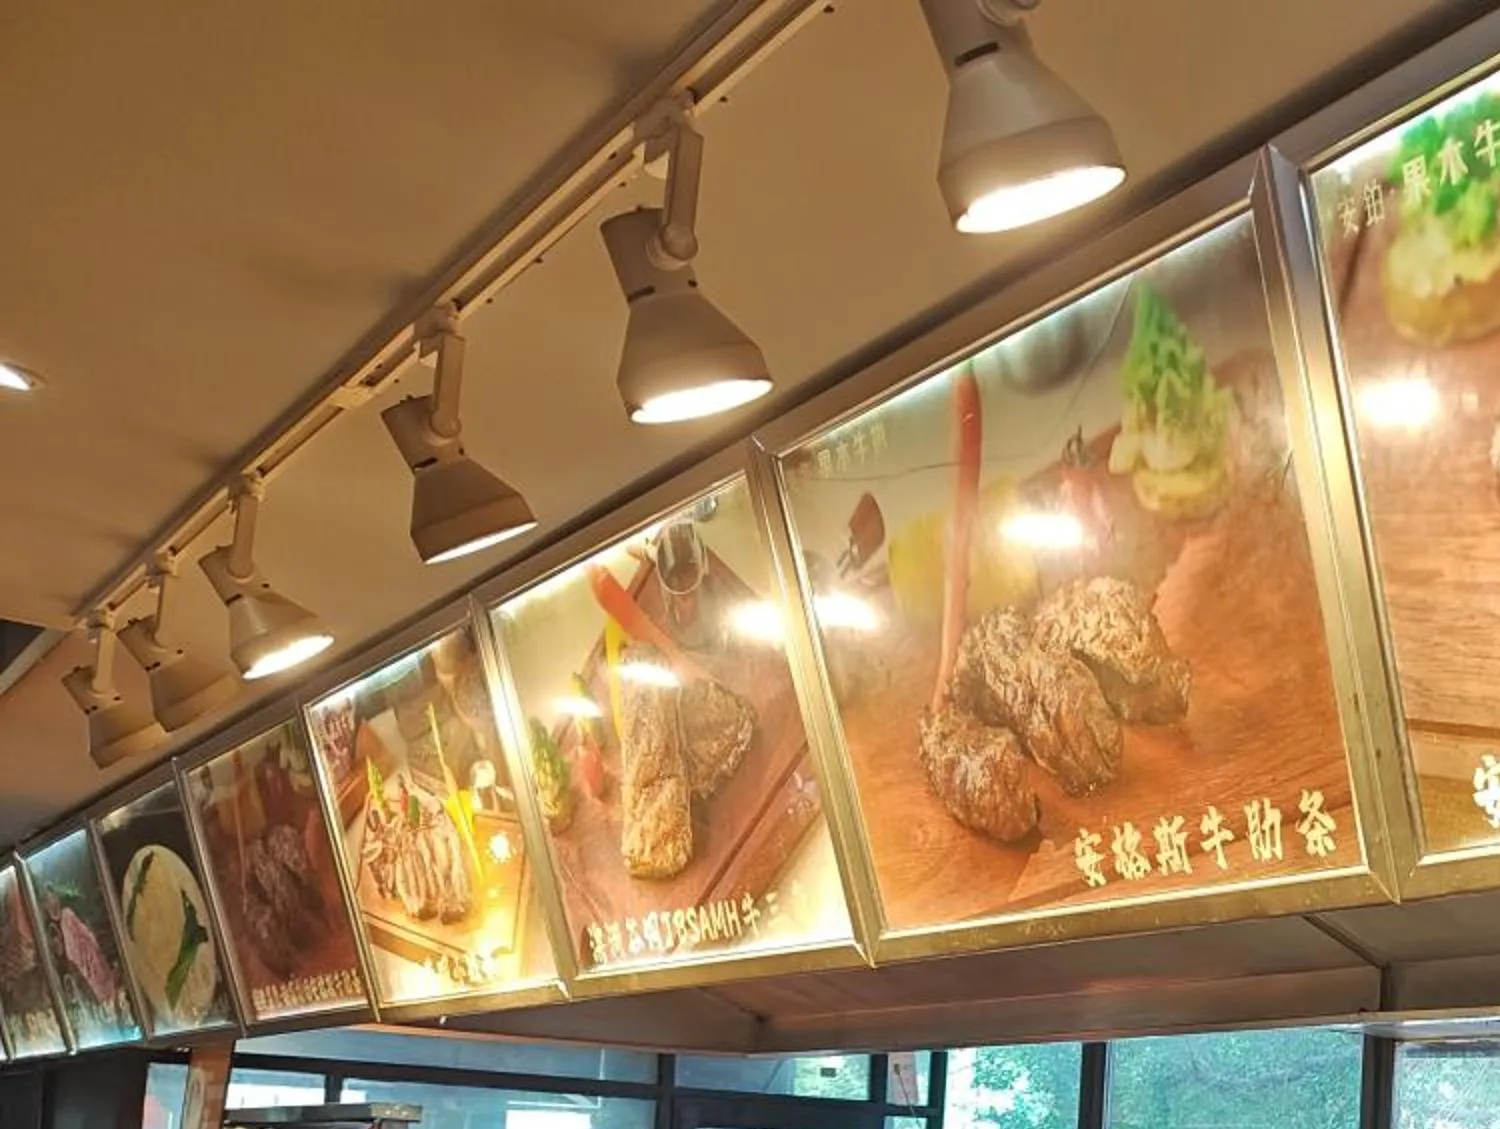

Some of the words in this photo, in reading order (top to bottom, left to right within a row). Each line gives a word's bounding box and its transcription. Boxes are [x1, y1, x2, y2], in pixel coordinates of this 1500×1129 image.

[1074, 788, 1338, 888] 安格斯牛肋条
